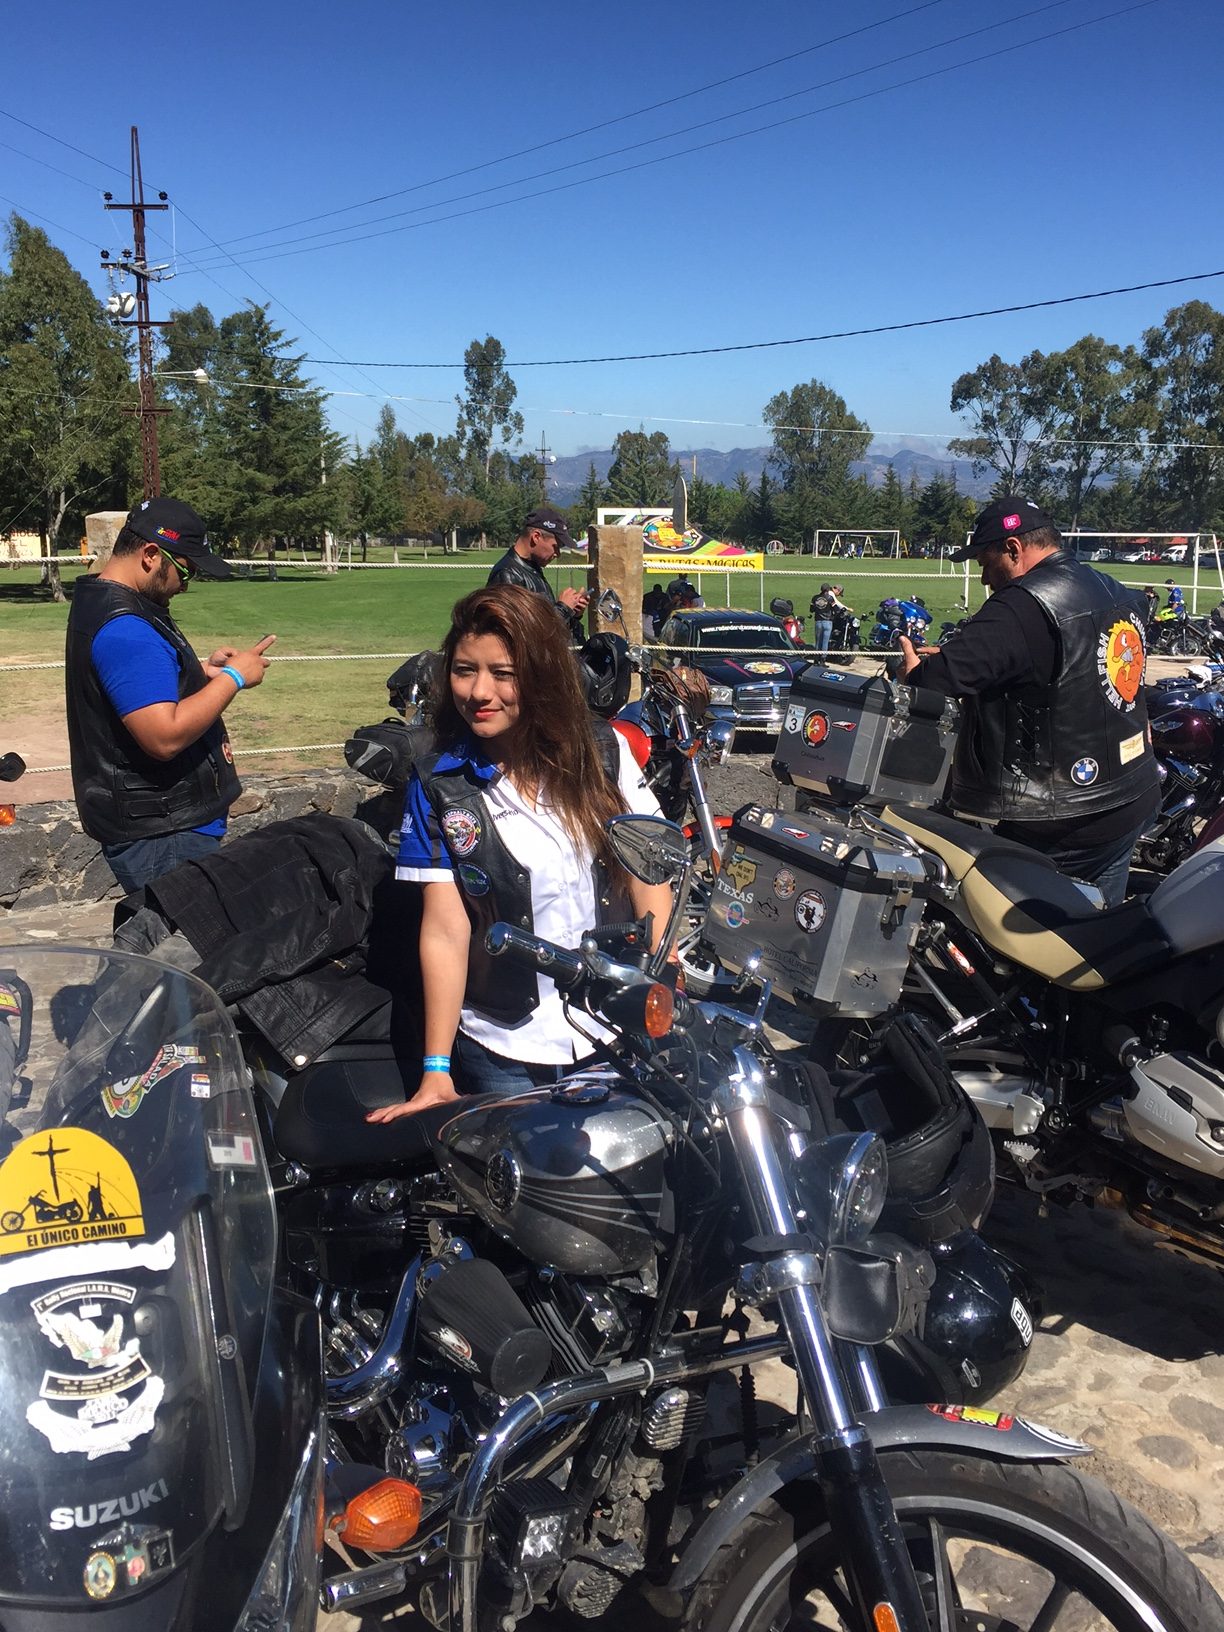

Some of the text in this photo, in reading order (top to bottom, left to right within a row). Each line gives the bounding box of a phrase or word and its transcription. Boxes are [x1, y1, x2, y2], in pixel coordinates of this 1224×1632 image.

[1096, 632, 1124, 711] HELL FISH
[789, 717, 799, 732] 3
[717, 878, 755, 904] TEXAS
[41, 1228, 79, 1245] ÚNICO
[82, 1222, 127, 1240] CAMINO
[49, 1478, 170, 1531] SUZUKI
